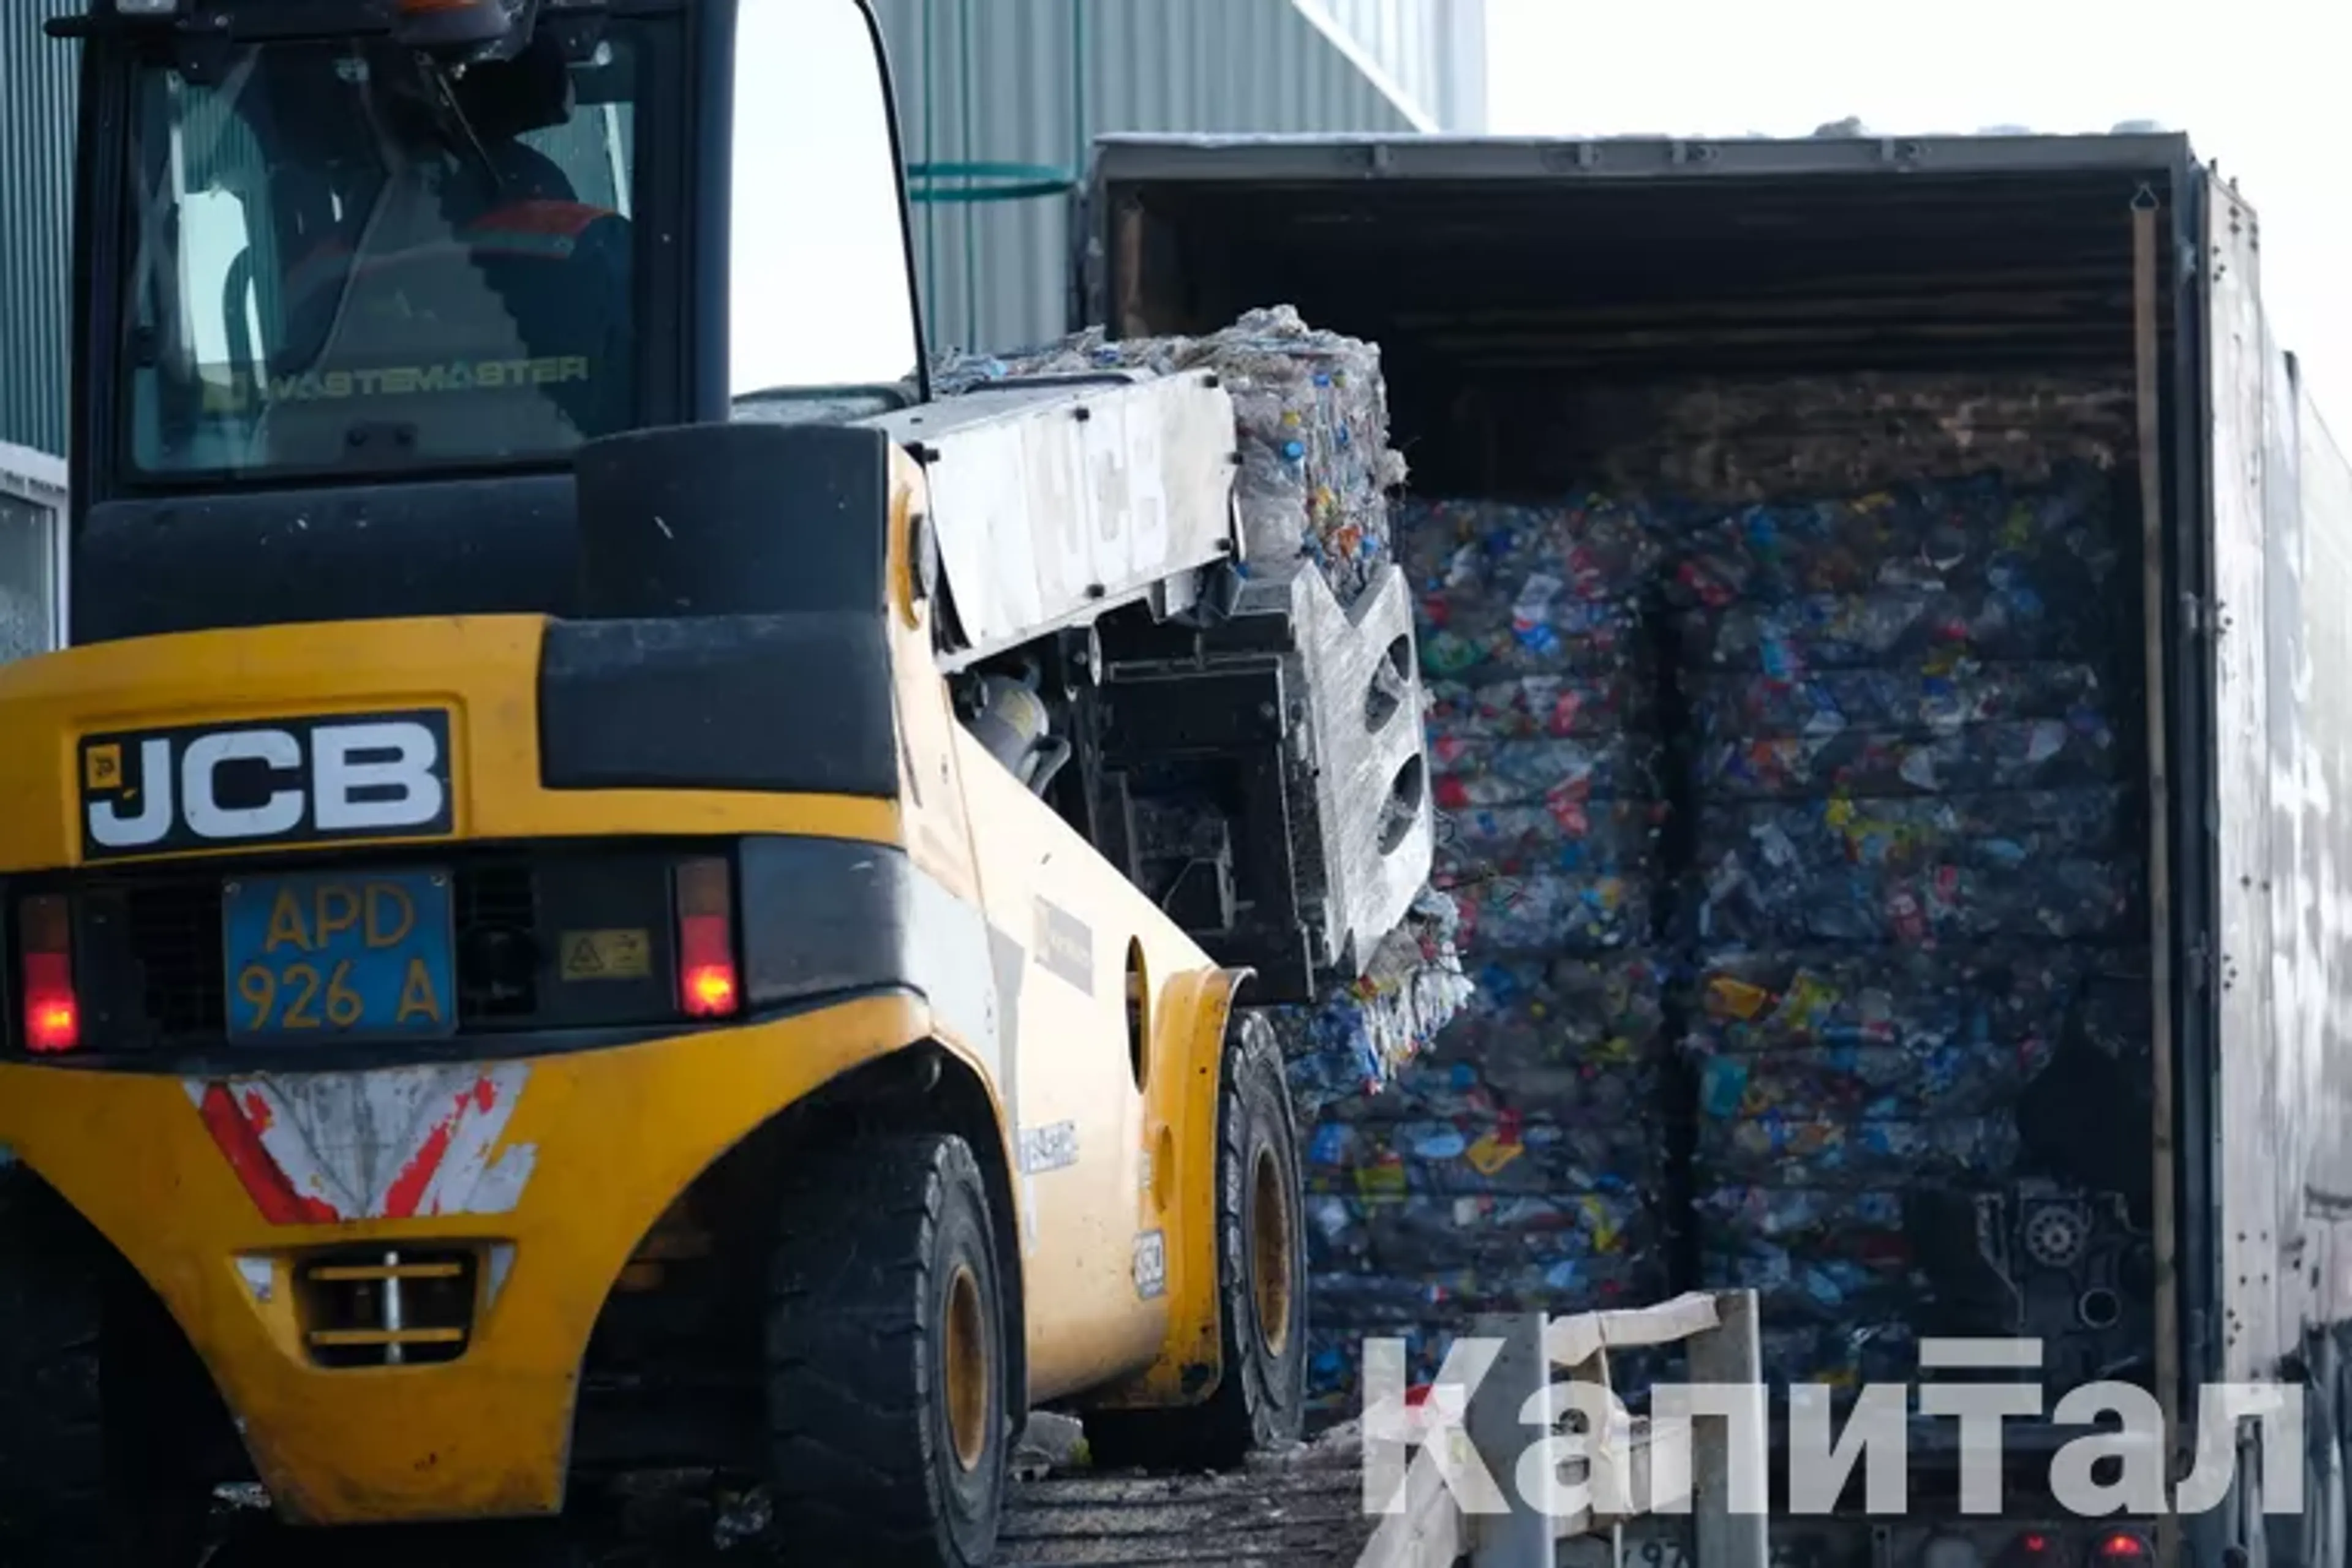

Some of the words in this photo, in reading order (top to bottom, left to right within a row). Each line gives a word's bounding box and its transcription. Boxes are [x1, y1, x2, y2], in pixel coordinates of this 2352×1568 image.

[268, 355, 589, 401] WASTEMASTER
[88, 721, 443, 846] JCB
[264, 882, 416, 954] APD
[238, 958, 363, 1031] 926
[396, 957, 441, 1024] A
